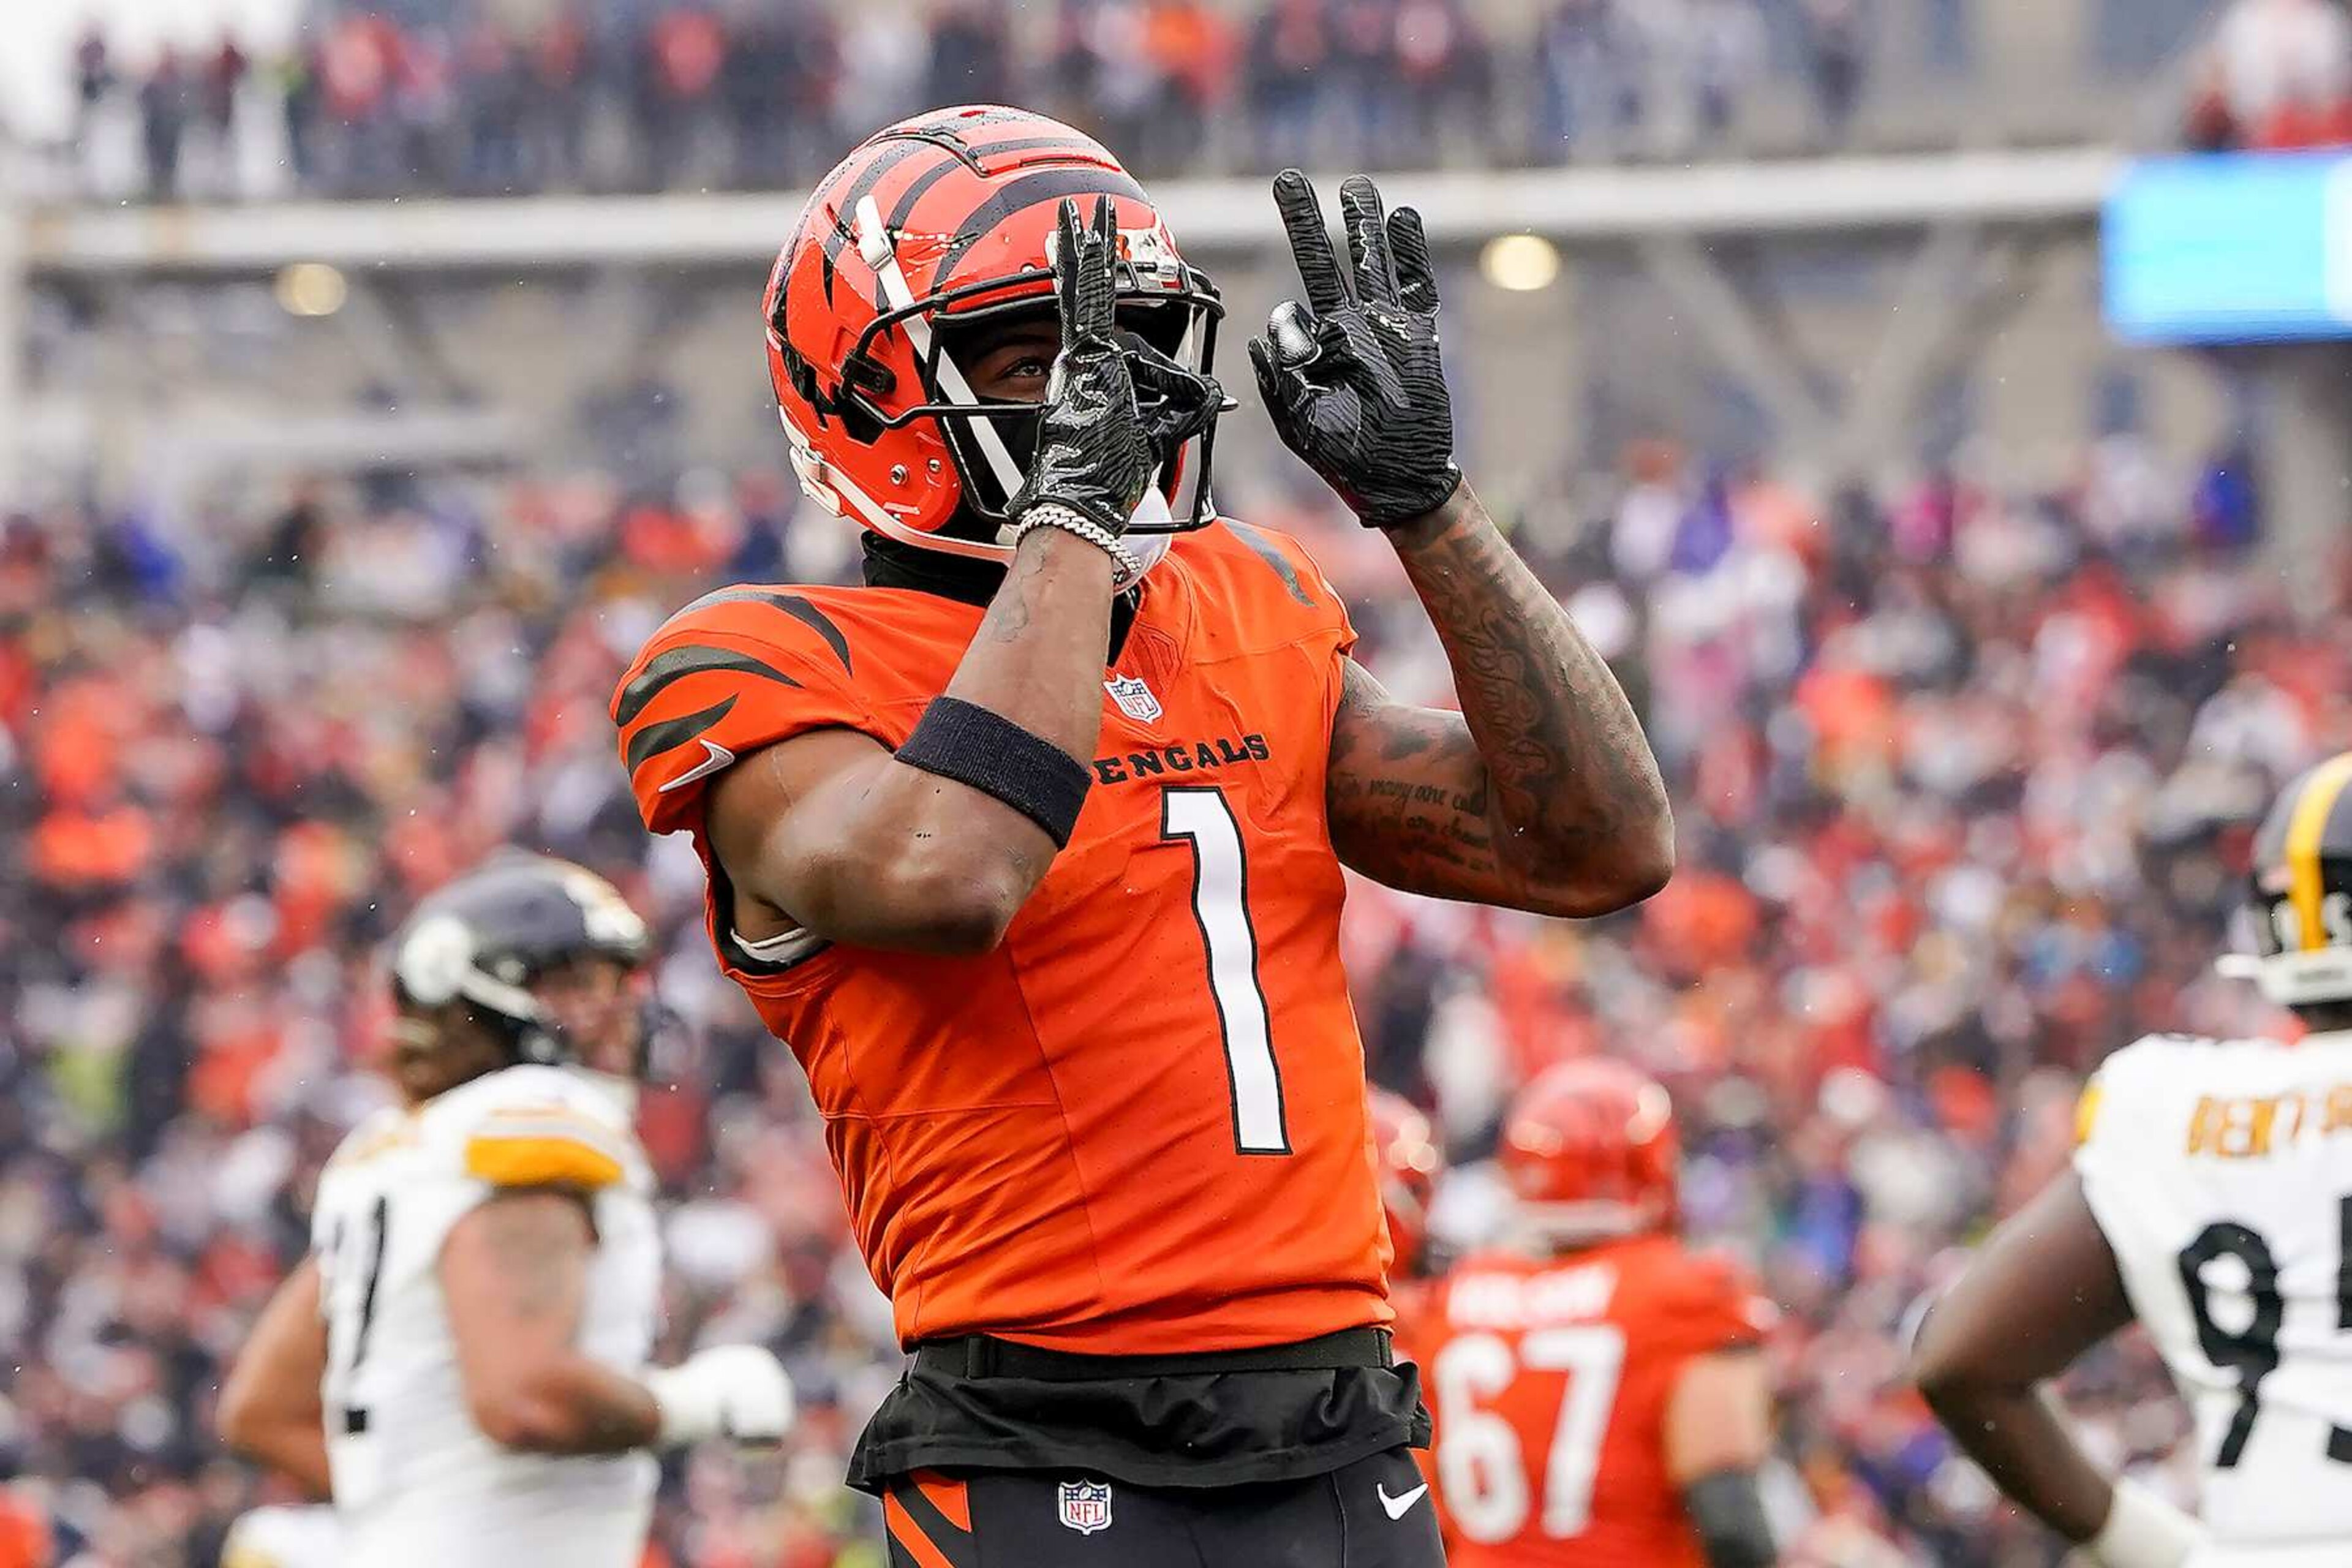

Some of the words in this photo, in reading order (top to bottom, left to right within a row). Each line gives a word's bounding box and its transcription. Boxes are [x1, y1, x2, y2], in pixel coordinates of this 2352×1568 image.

[1093, 734, 1270, 785] ENGALS
[1123, 696, 1155, 715] NFL
[1161, 786, 1293, 1155] 1
[2179, 1194, 2352, 1468] 9
[1433, 1324, 1628, 1544] 67
[1070, 1502, 1103, 1522] NFL
